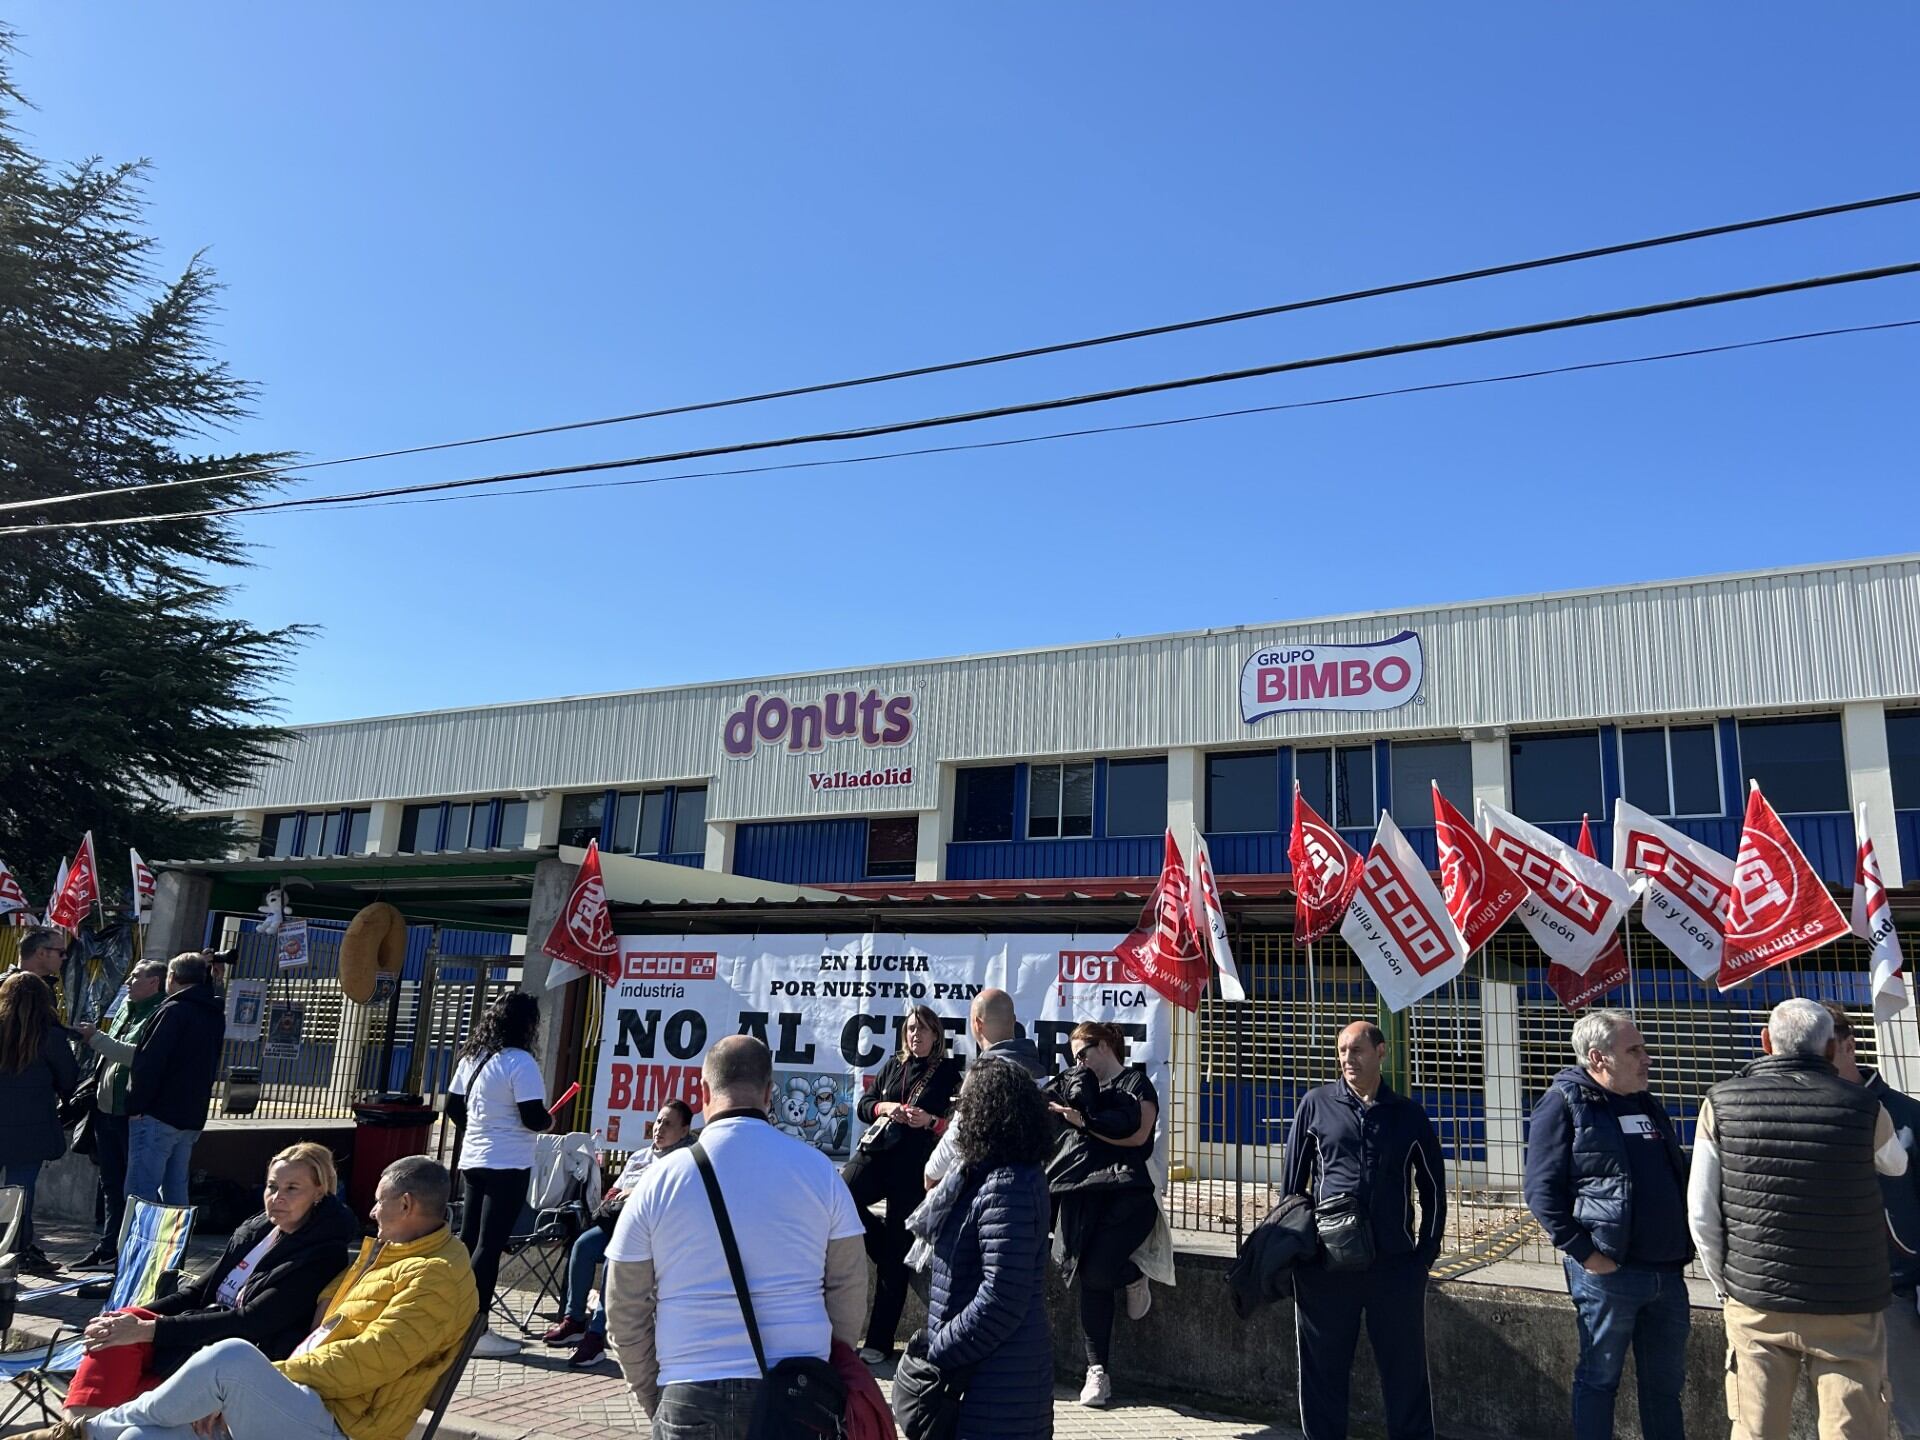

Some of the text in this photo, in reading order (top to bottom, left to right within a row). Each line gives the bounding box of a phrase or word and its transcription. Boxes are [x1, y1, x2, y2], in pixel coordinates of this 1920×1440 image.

[1257, 649, 1315, 666] GRUPO
[1257, 656, 1412, 704] BIMBO
[723, 688, 913, 754] donuts
[808, 766, 912, 790] Valladolid
[1496, 837, 1600, 922] CCOO
[1362, 854, 1446, 964] CCOO
[1463, 888, 1513, 940] ww.ugt.es
[1527, 904, 1576, 943] y León
[1665, 907, 1681, 920] y
[1679, 915, 1714, 951] León
[1350, 898, 1403, 976] stilla y León
[1726, 918, 1825, 970] www.ugt.es
[628, 957, 686, 975] CCOO
[819, 955, 930, 972] EN LUCHA
[1061, 955, 1120, 981] UGT
[620, 982, 685, 998] industria
[769, 980, 984, 1000] POR NUESTRO PAN
[1101, 989, 1148, 1008] FICA
[613, 1008, 708, 1060] NO
[736, 1011, 816, 1065] AL
[607, 1063, 705, 1114] BIMB
